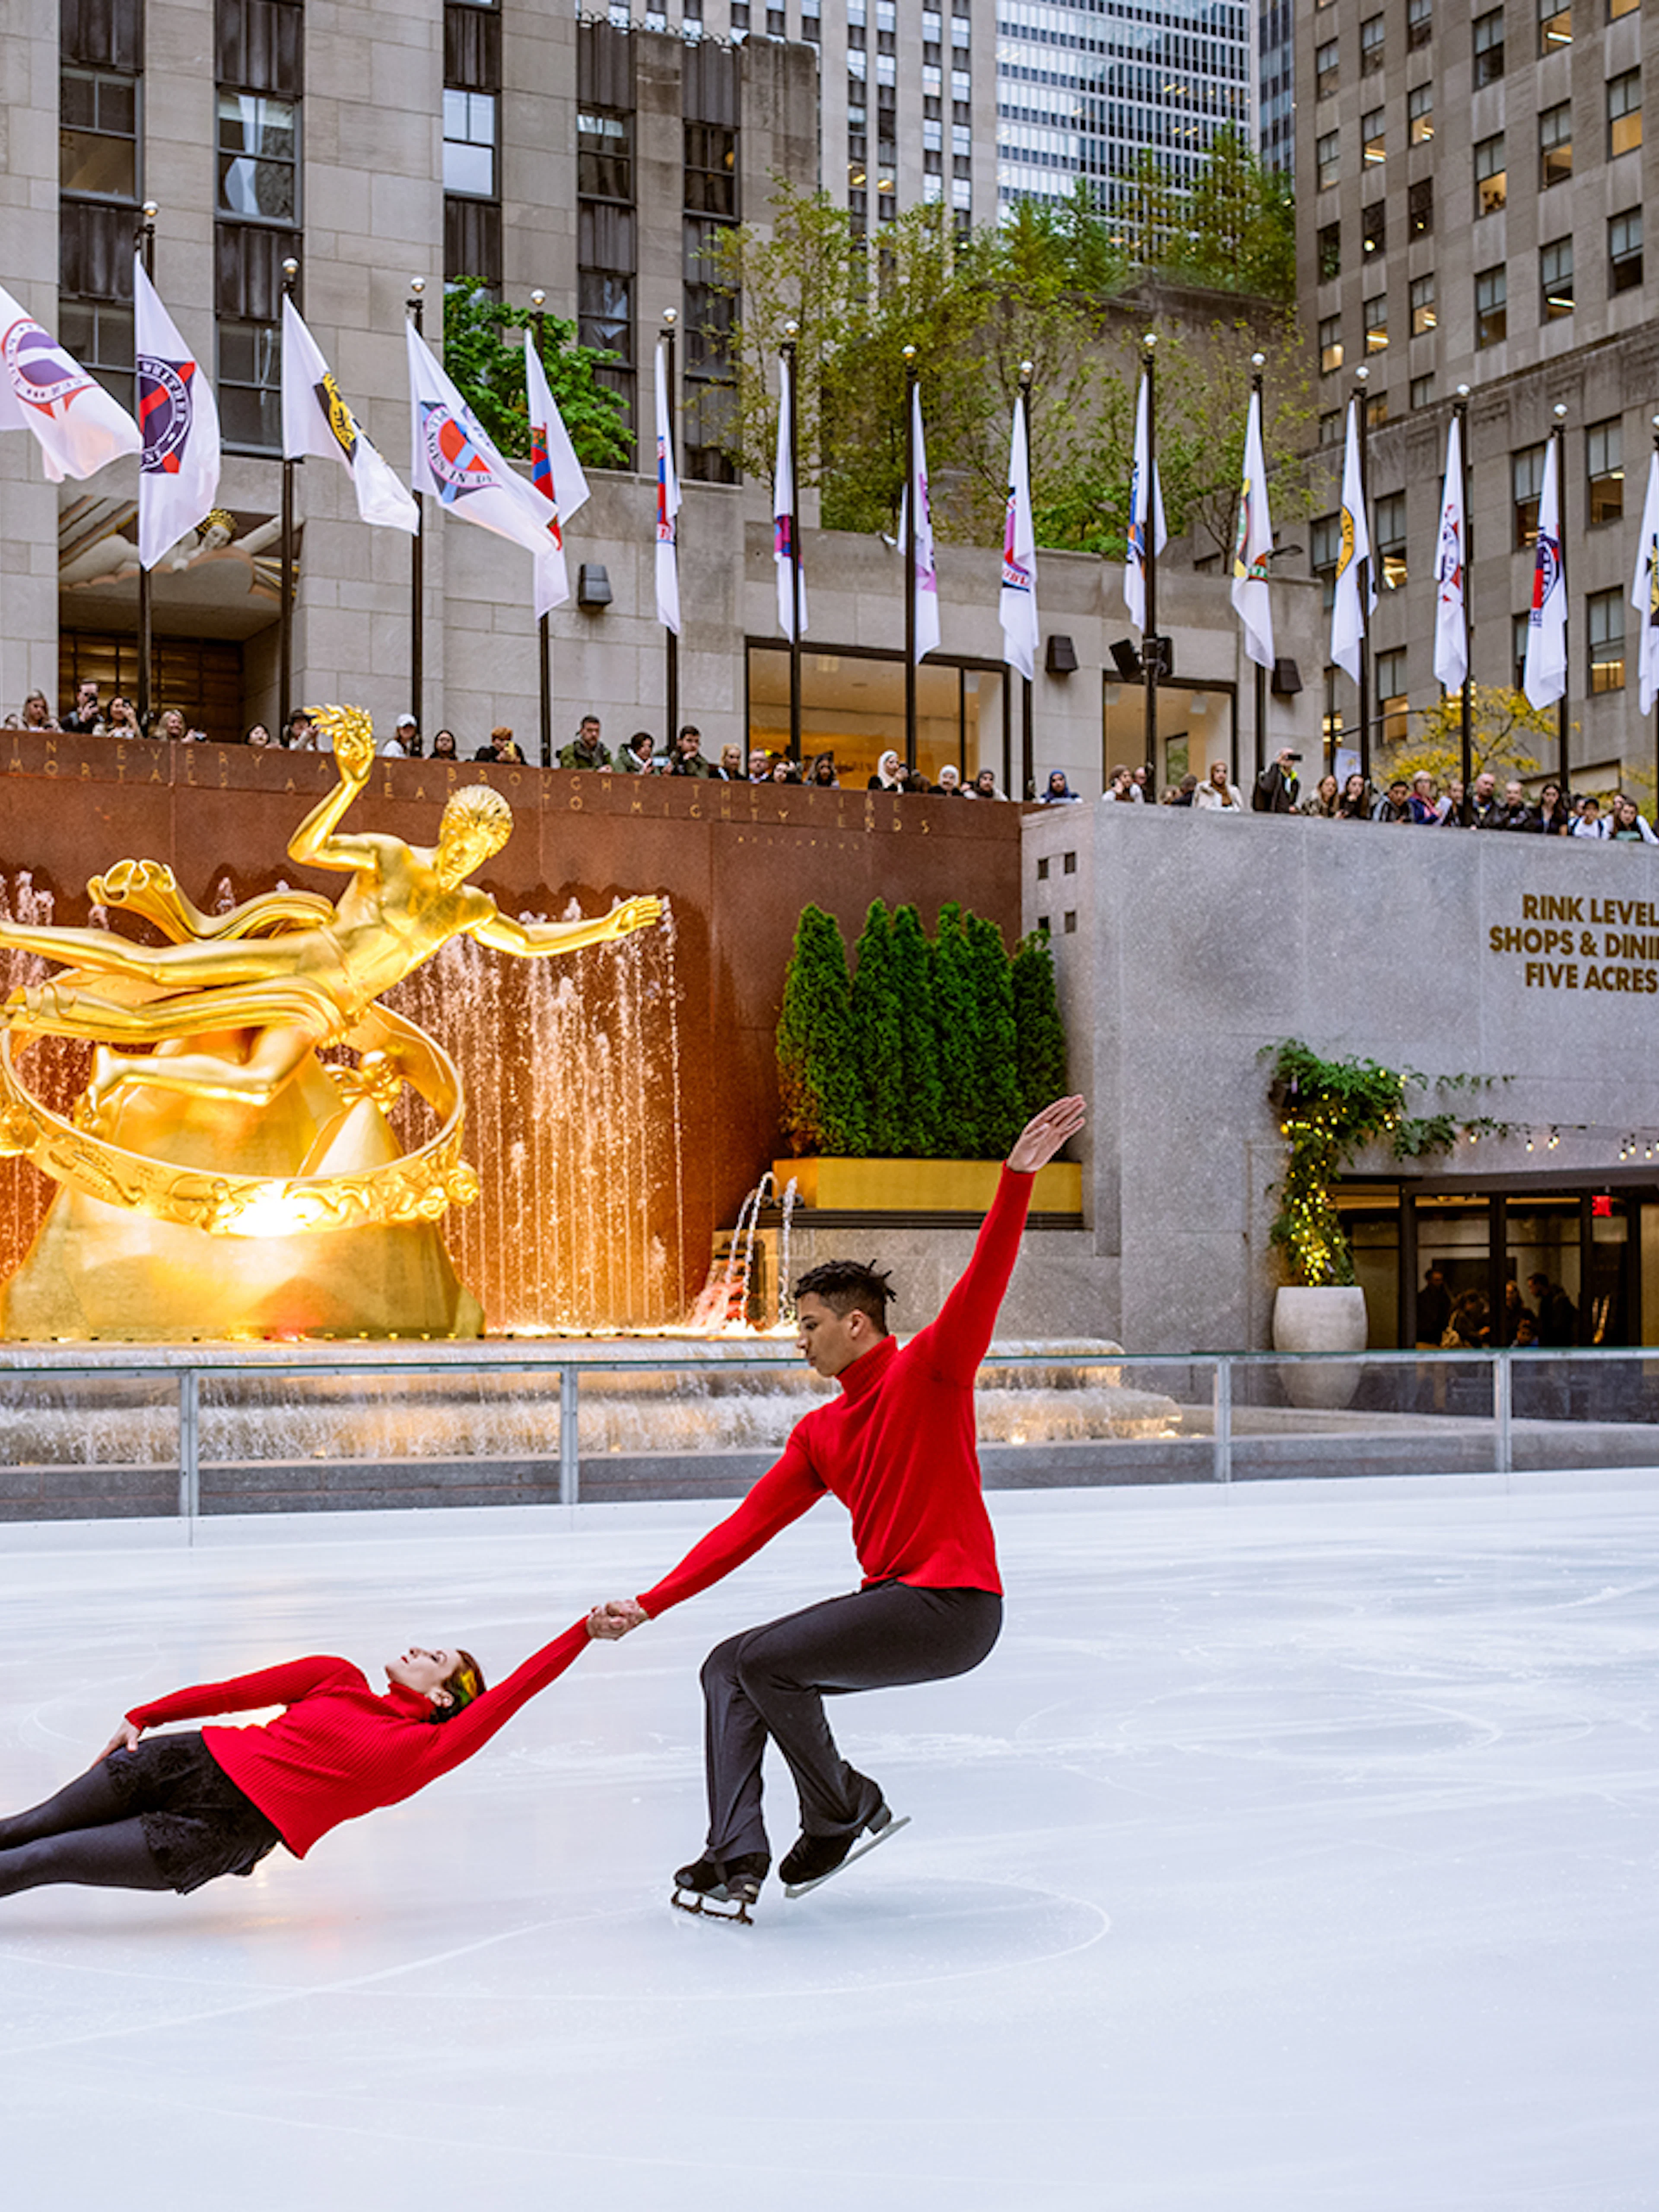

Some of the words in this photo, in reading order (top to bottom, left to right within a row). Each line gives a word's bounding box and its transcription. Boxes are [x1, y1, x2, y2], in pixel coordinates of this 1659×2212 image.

[9, 758, 228, 788] MORTALS
[285, 777, 297, 792] A
[543, 793, 583, 811] TO
[629, 801, 790, 822] MIGHTY
[13, 737, 57, 753] IN
[116, 744, 263, 768] EVERY
[447, 766, 640, 794] BROUGHT
[693, 784, 760, 803] THE
[809, 793, 901, 813] FIRE
[1522, 894, 1585, 922] RINK
[1590, 898, 1659, 928] LEVEL
[1489, 925, 1574, 955] SHOPS
[1580, 931, 1598, 957] &
[1605, 931, 1659, 960] DINI
[1526, 962, 1578, 988] FIVE
[1583, 965, 1658, 995] ACRES
